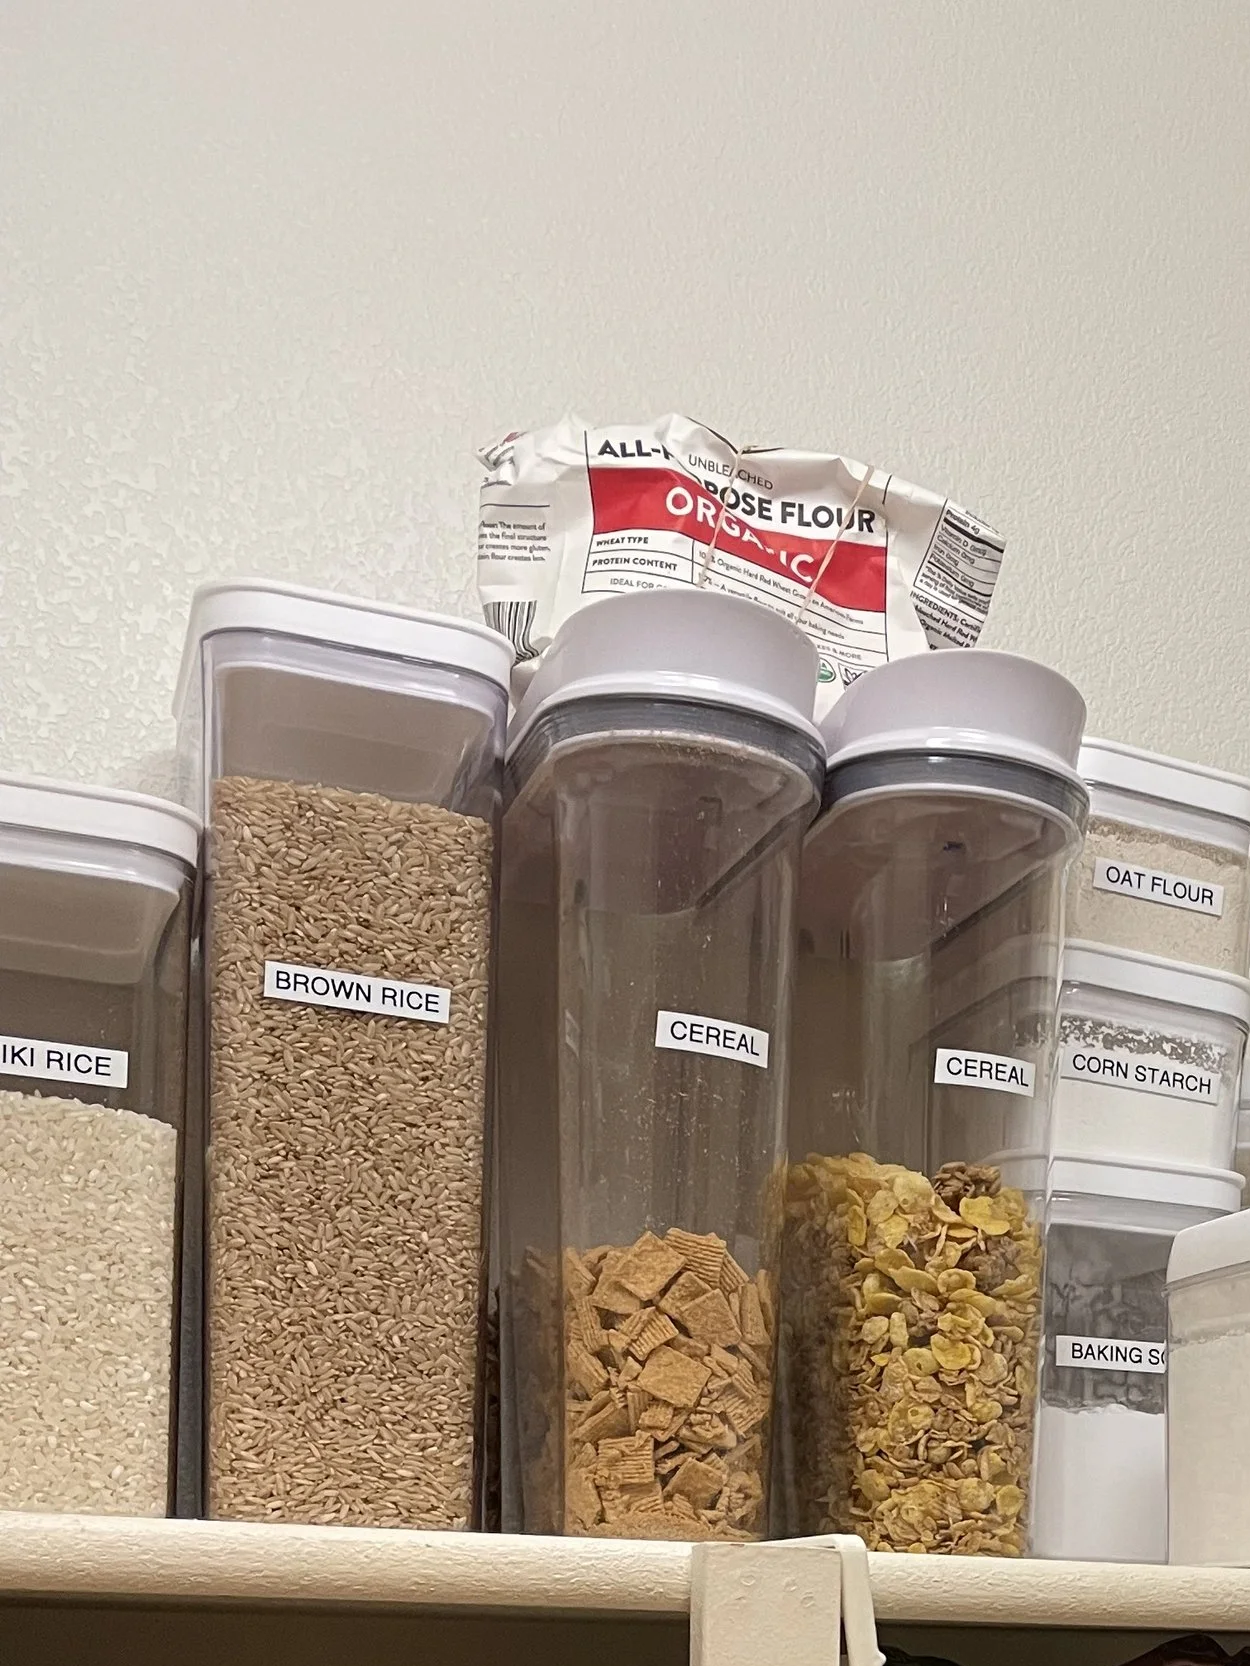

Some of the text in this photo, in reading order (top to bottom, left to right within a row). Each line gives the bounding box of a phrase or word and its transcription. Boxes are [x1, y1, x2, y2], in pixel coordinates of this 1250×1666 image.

[781, 501, 876, 534] FLOUR
[596, 536, 649, 547] WHEAT TYPE
[592, 557, 678, 571] PROTEIN CONTENT
[717, 558, 743, 577] Organic
[609, 577, 656, 589] IDEAL FOR
[1105, 865, 1214, 907] OAT FLOUR
[275, 969, 441, 1014] BROWN RICE
[669, 1020, 760, 1058] CEREAL
[1, 1043, 113, 1078] IKI RICE
[945, 1056, 1030, 1088] CEREAL
[1072, 1053, 1213, 1095] CORN STARCH
[1070, 1342, 1144, 1365] BAKING
